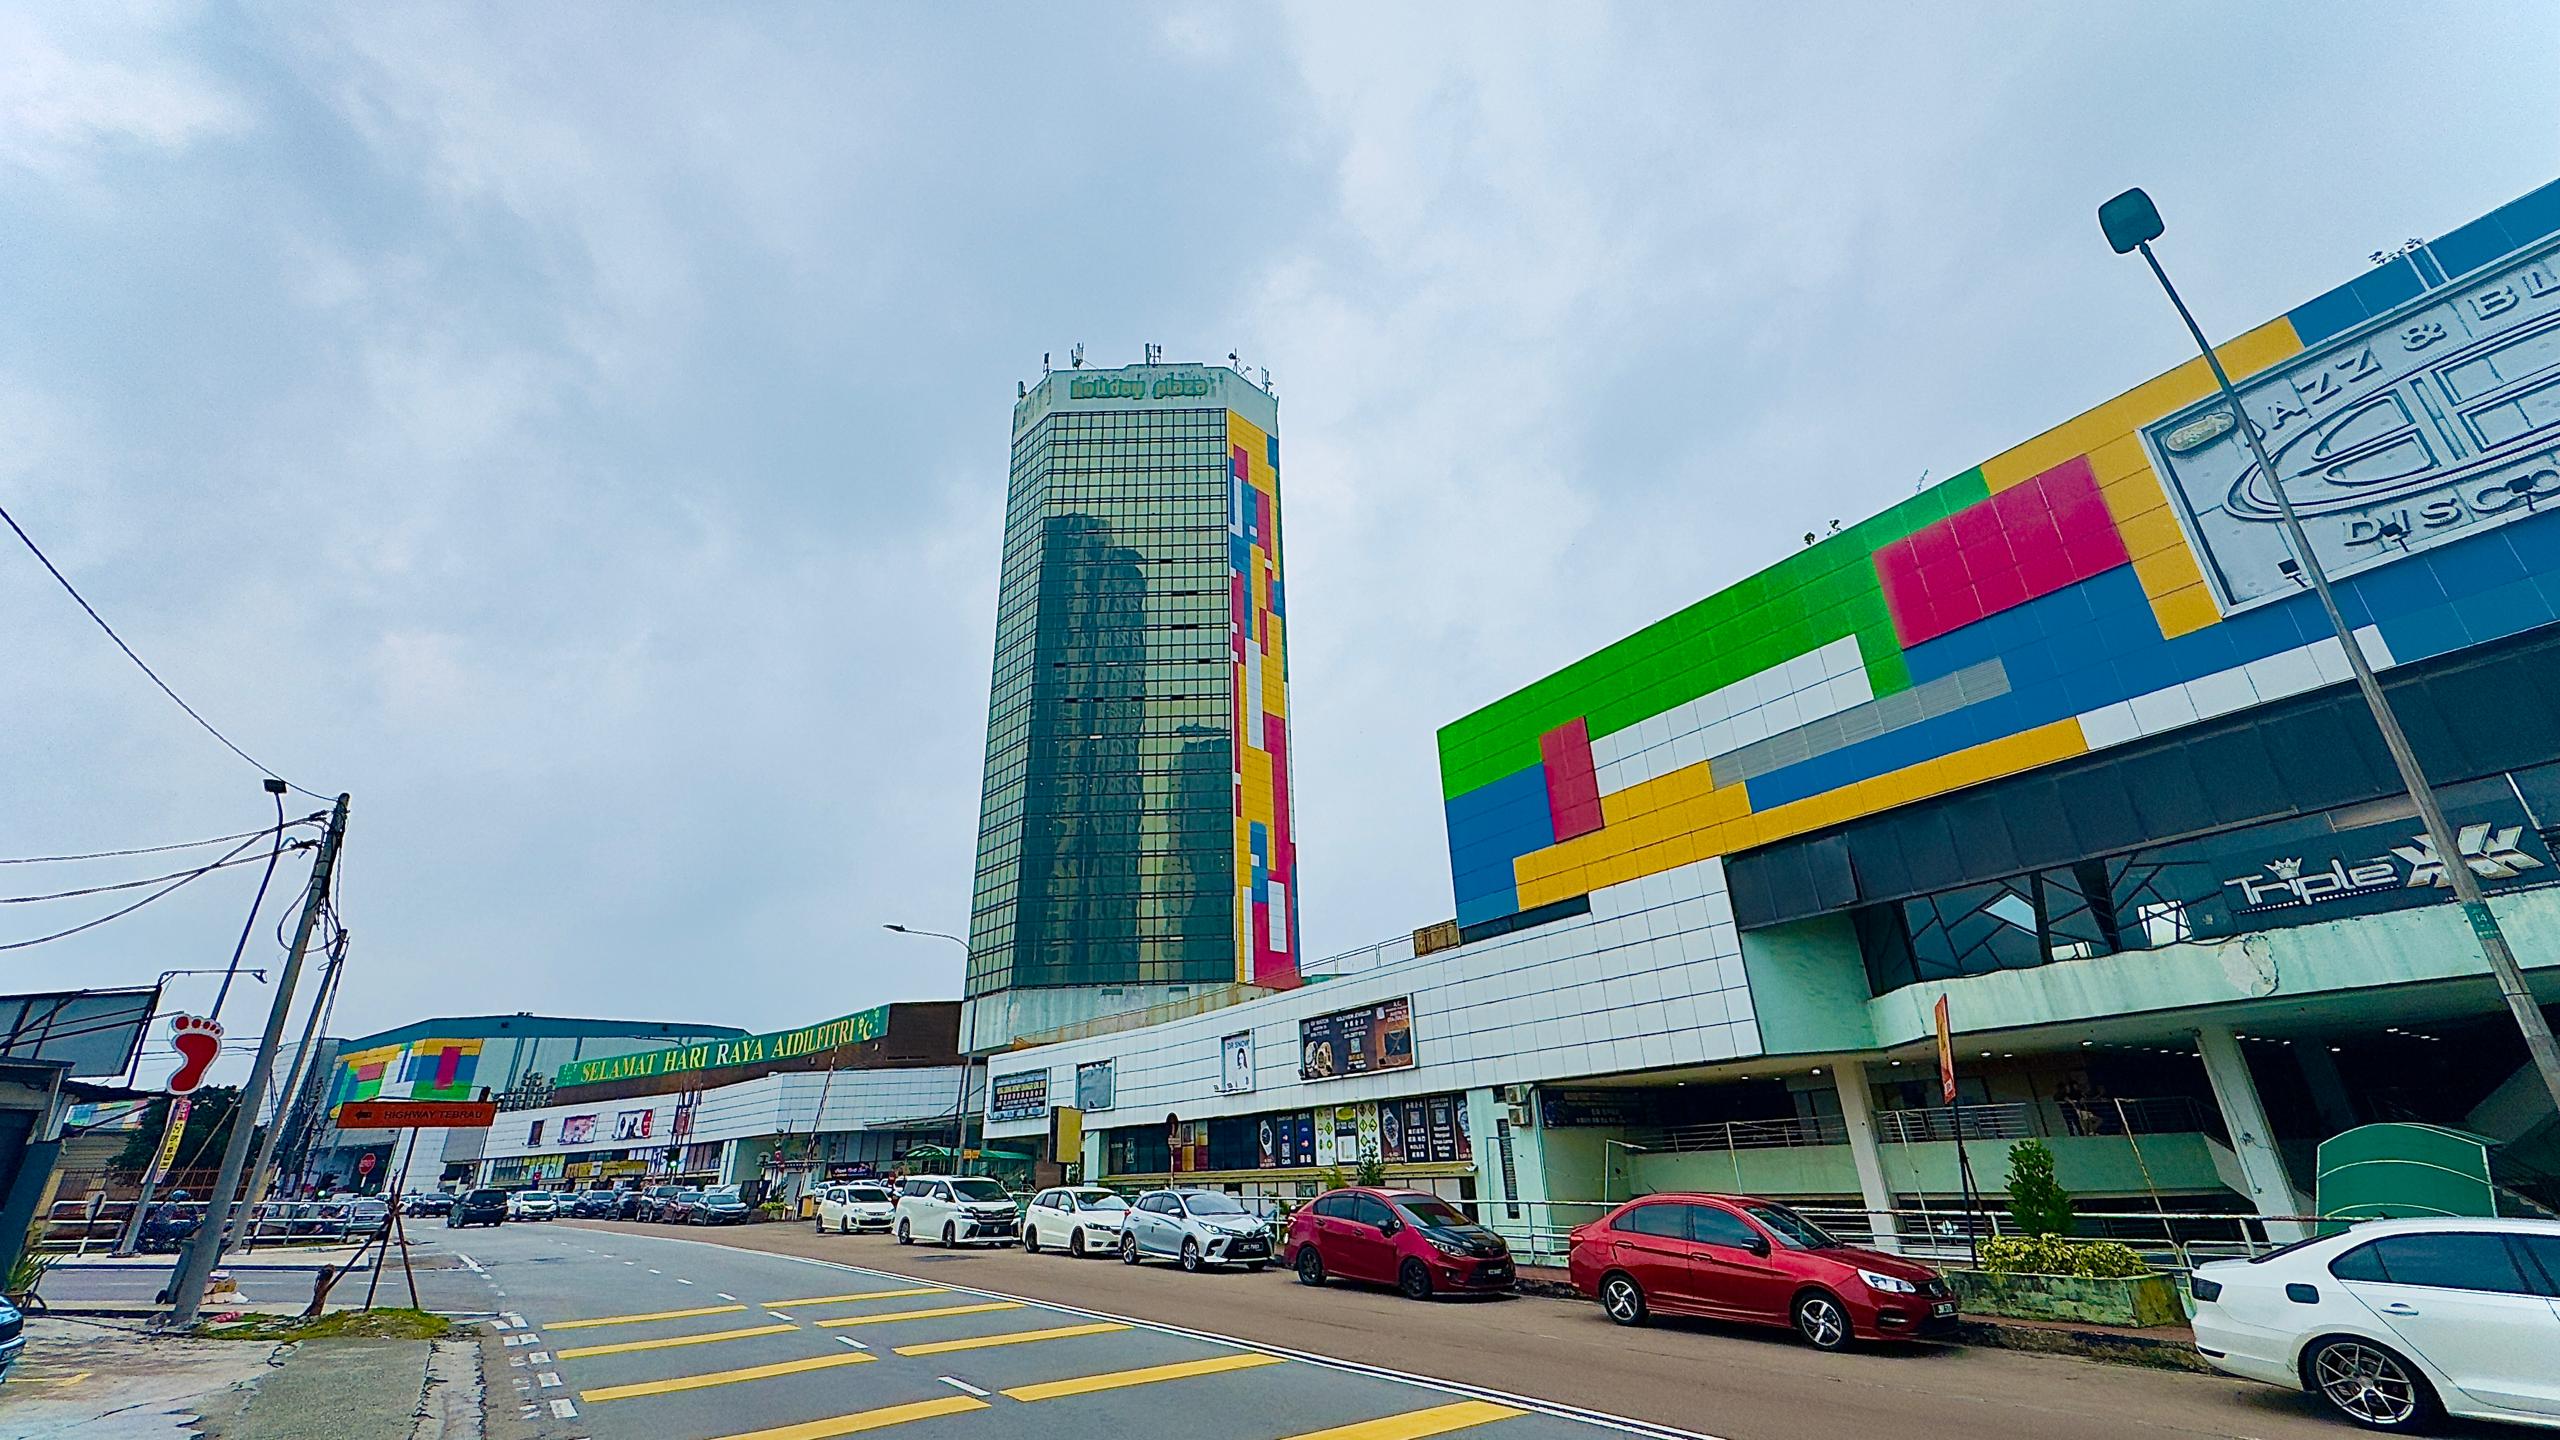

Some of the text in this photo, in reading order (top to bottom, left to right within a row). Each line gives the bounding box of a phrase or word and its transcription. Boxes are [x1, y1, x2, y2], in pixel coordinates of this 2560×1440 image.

[2401, 321, 2448, 351] &
[2223, 858, 2399, 906] Triple
[581, 1018, 856, 1083] SELAMAT HARI RAYA AIDILFITRI
[383, 1110, 483, 1120] HIGHWAY TEBRAU
